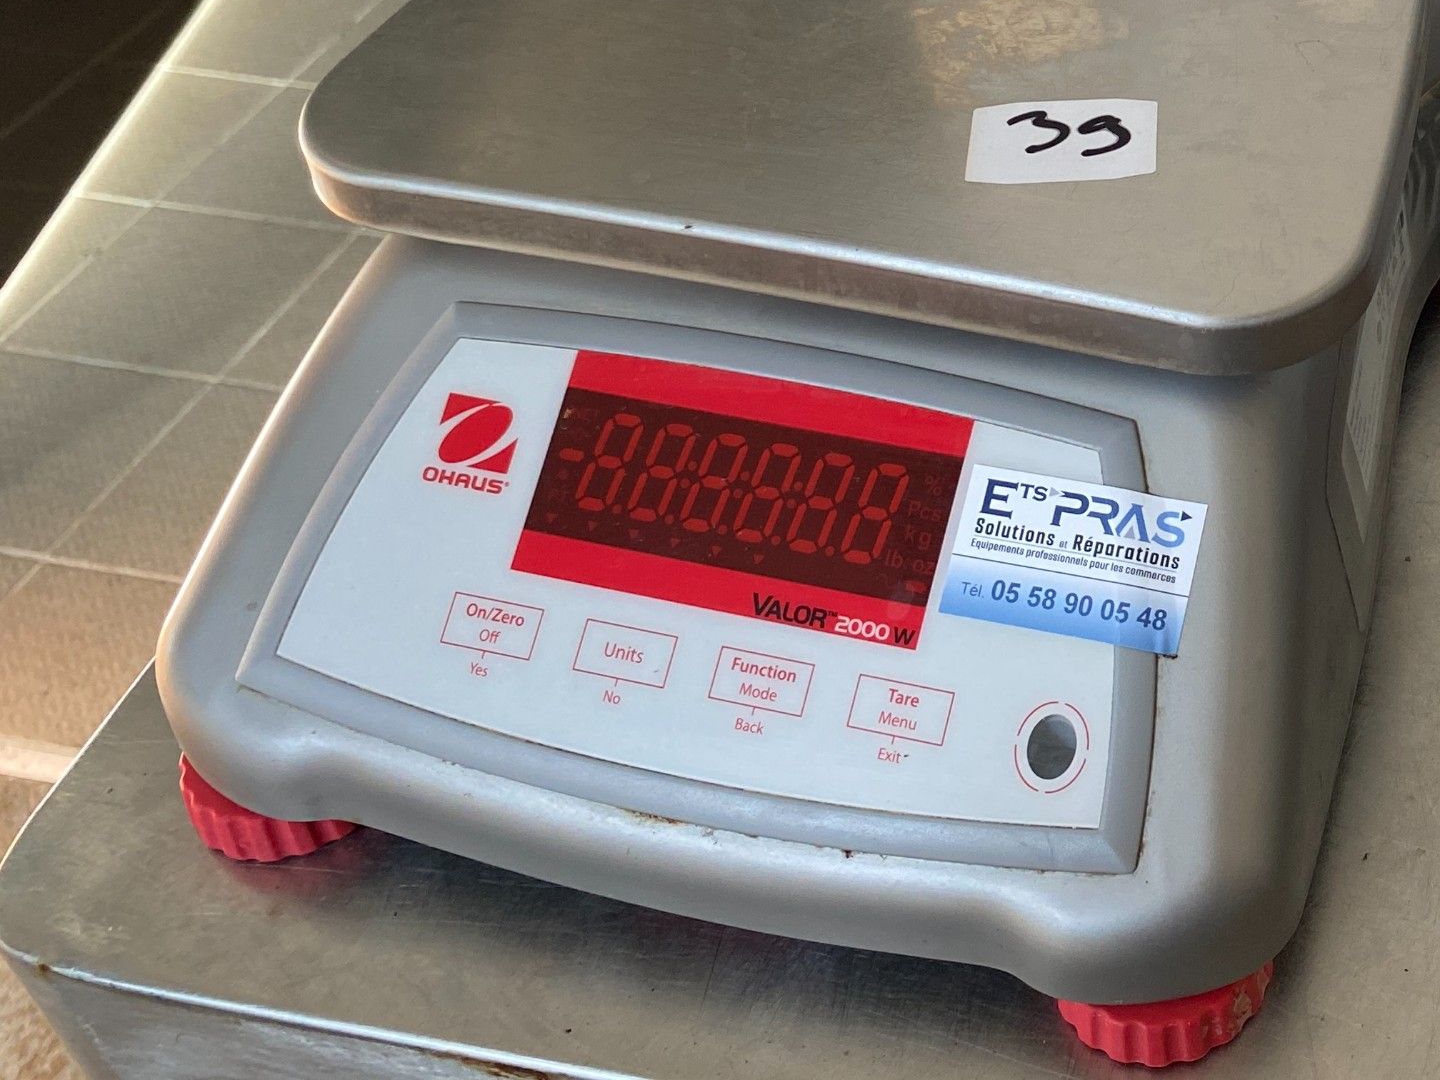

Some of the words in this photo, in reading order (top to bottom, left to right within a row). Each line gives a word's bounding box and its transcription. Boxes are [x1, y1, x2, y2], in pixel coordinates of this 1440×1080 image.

[1007, 110, 1132, 157] 39
[422, 466, 505, 495] OHAUS
[1050, 490, 1187, 548] PRAS
[974, 517, 1056, 546] Solutions
[1059, 537, 1068, 549] et
[1073, 534, 1180, 570] Réparations
[971, 538, 1025, 556] Equipements
[1025, 546, 1088, 568] professionnels
[1089, 560, 1109, 572] pour
[1110, 561, 1124, 573] les
[1125, 566, 1176, 584] commerces
[466, 603, 525, 627] On/Zero
[961, 581, 985, 598] Tél.
[991, 579, 1021, 604] 05
[1027, 586, 1057, 610] 58
[1063, 592, 1094, 617] 90
[1100, 599, 1131, 623] 05
[1136, 606, 1168, 631] 48
[479, 629, 502, 645] Off
[834, 615, 891, 641] 2000
[894, 626, 917, 645] W
[604, 641, 645, 664] Units
[469, 662, 488, 677] Yes
[731, 657, 797, 682] Function
[602, 690, 621, 705] No
[739, 683, 778, 702] Mode
[888, 688, 920, 708] Tare
[734, 717, 765, 735] Back
[878, 711, 917, 731] Menu
[877, 748, 902, 764] Exit
